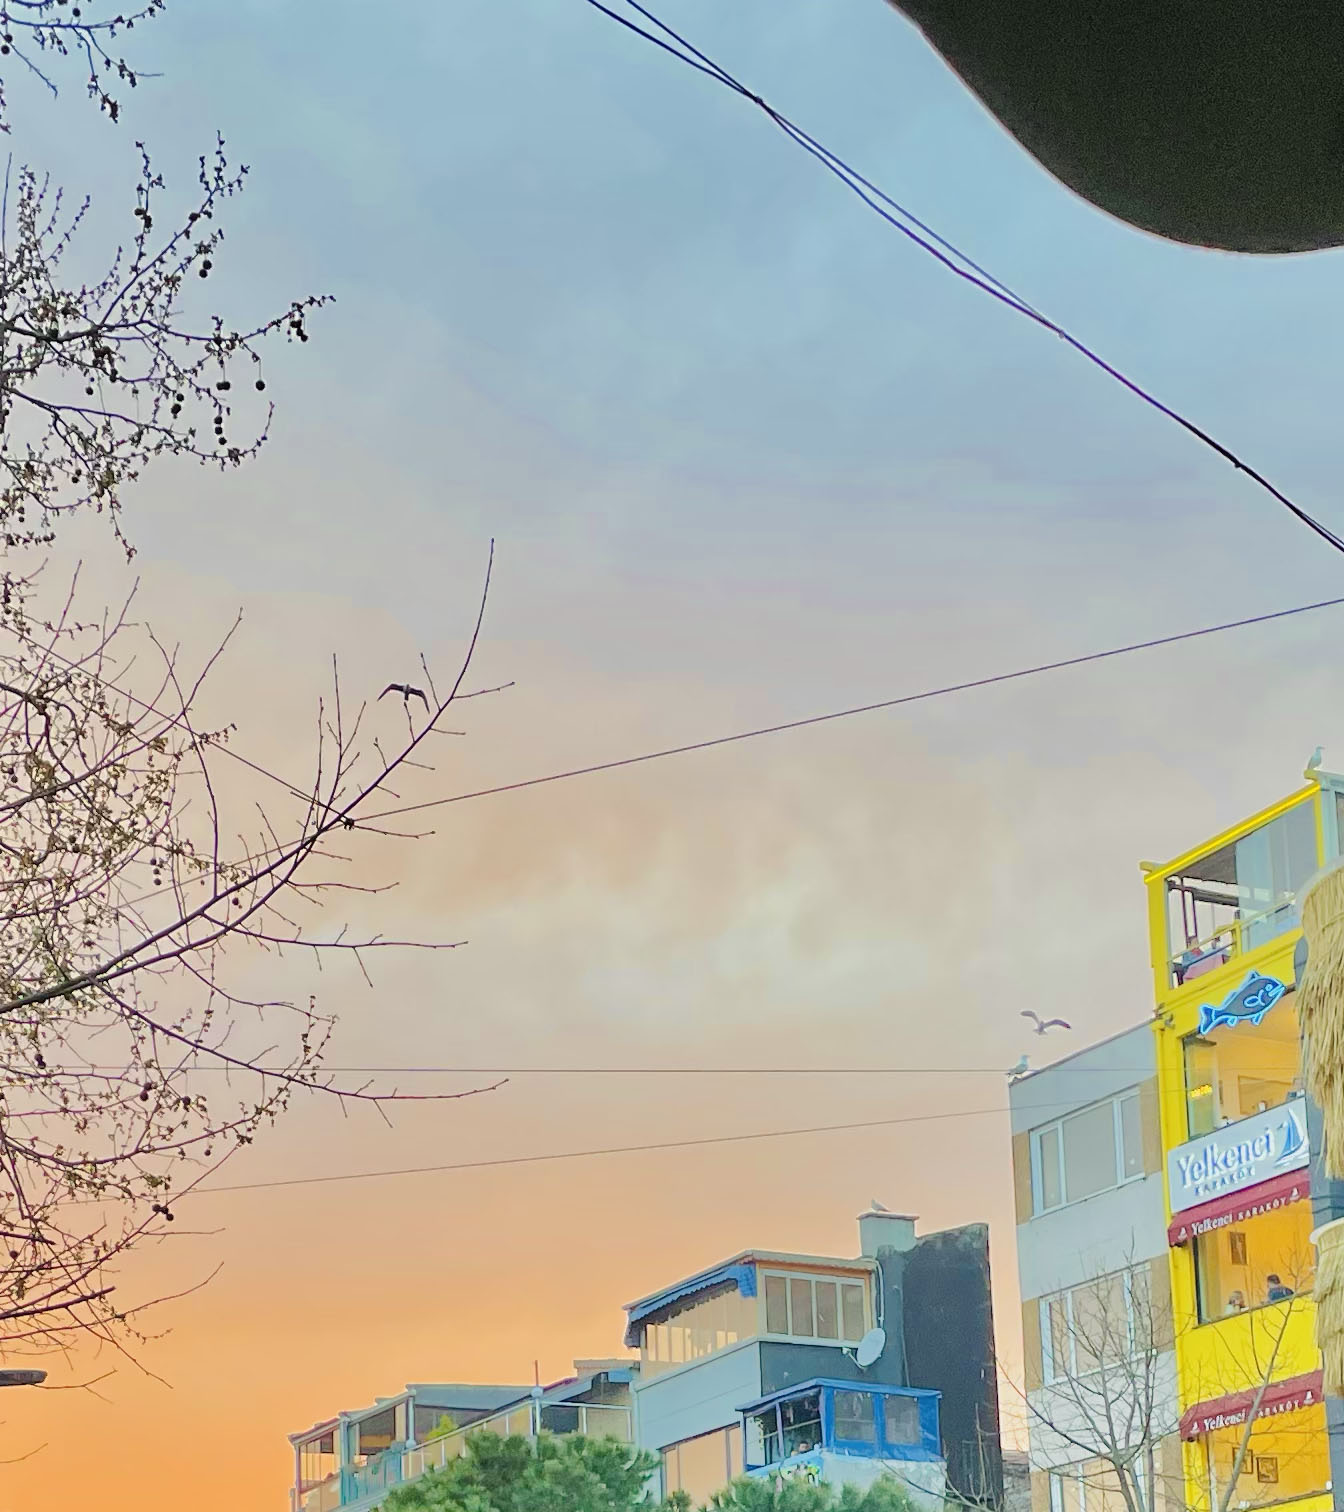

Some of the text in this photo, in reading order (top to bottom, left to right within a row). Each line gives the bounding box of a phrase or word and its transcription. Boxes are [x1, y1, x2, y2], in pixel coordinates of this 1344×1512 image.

[1177, 1127, 1274, 1188] Yelkenci
[1191, 1196, 1287, 1235] Yelkenci KARAKÖY
[1204, 1400, 1300, 1431] Yelkenci ARAKÖY
